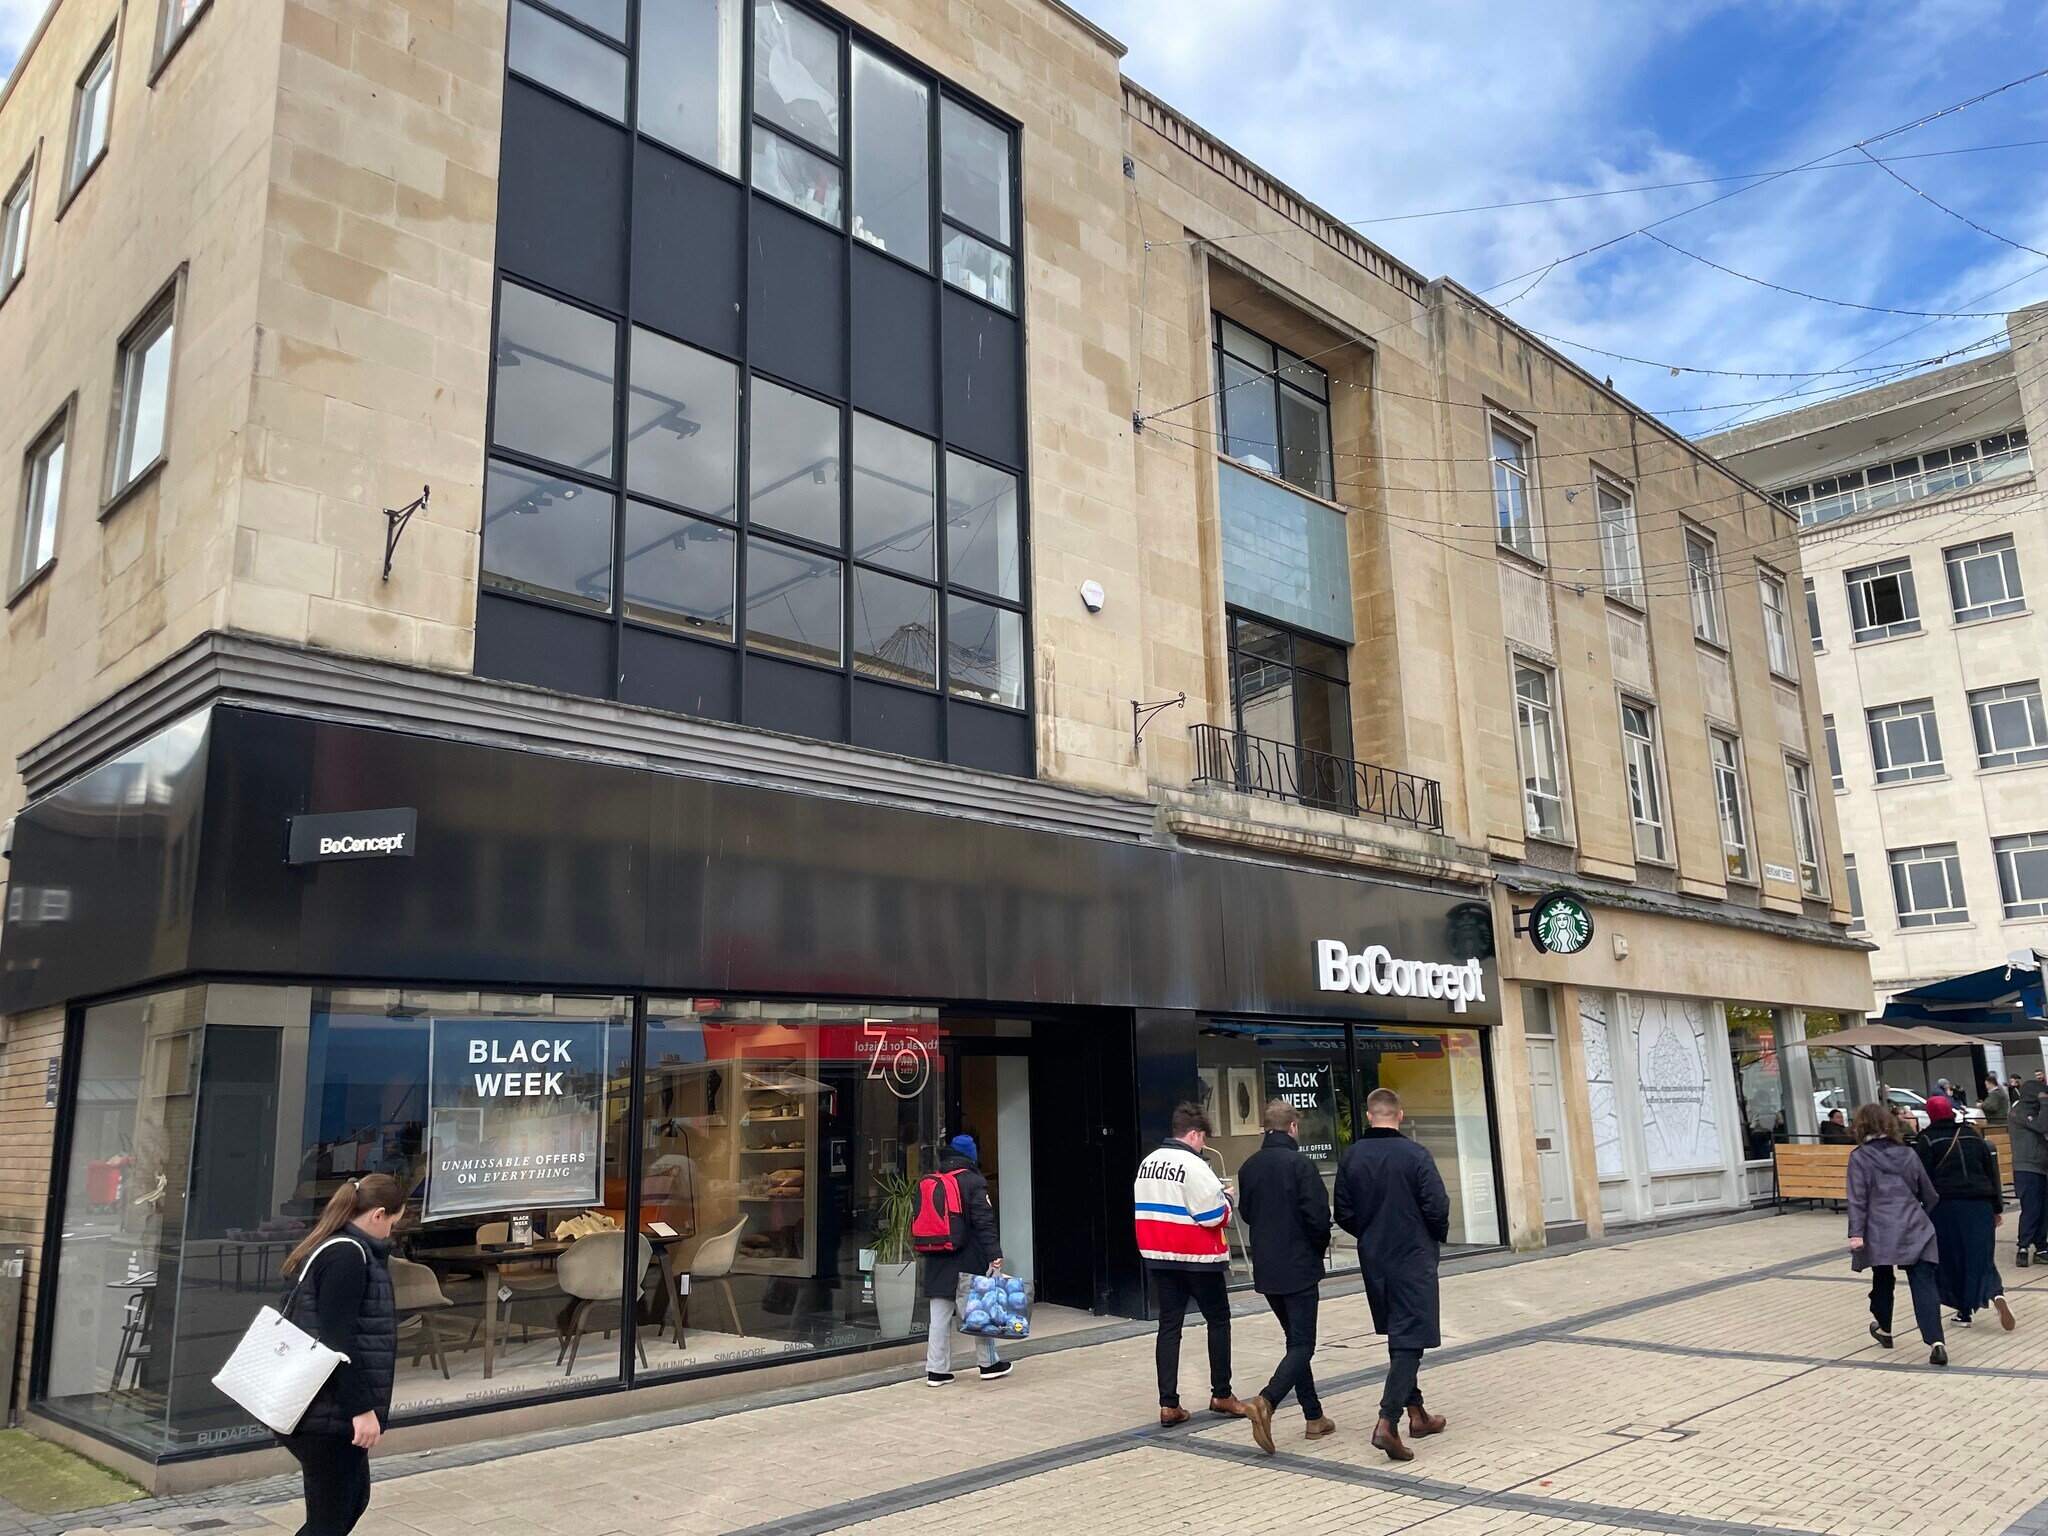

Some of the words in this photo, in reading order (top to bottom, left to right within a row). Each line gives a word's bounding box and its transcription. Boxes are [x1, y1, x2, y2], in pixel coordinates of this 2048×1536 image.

[319, 833, 405, 855] BoConcept
[1313, 939, 1486, 1013] BoConcept
[468, 1039, 573, 1064] BLACK
[474, 1072, 564, 1097] WEEK
[1277, 1072, 1319, 1088] BLACK
[1281, 1092, 1318, 1109] WEEK
[1310, 1143, 1332, 1152] OFFERS
[441, 1156, 531, 1171] UNMISSABLE
[535, 1152, 586, 1166] OFFERS
[1139, 1161, 1186, 1183] hildish
[457, 1173, 477, 1184] ON
[483, 1167, 571, 1183] EVERYTHING
[713, 1346, 767, 1362] SINGAPORE
[783, 1340, 809, 1352] PARIS
[823, 1332, 859, 1347] SYDNEY
[465, 1384, 527, 1401] SHANGHAI
[546, 1374, 599, 1390] TORONTO
